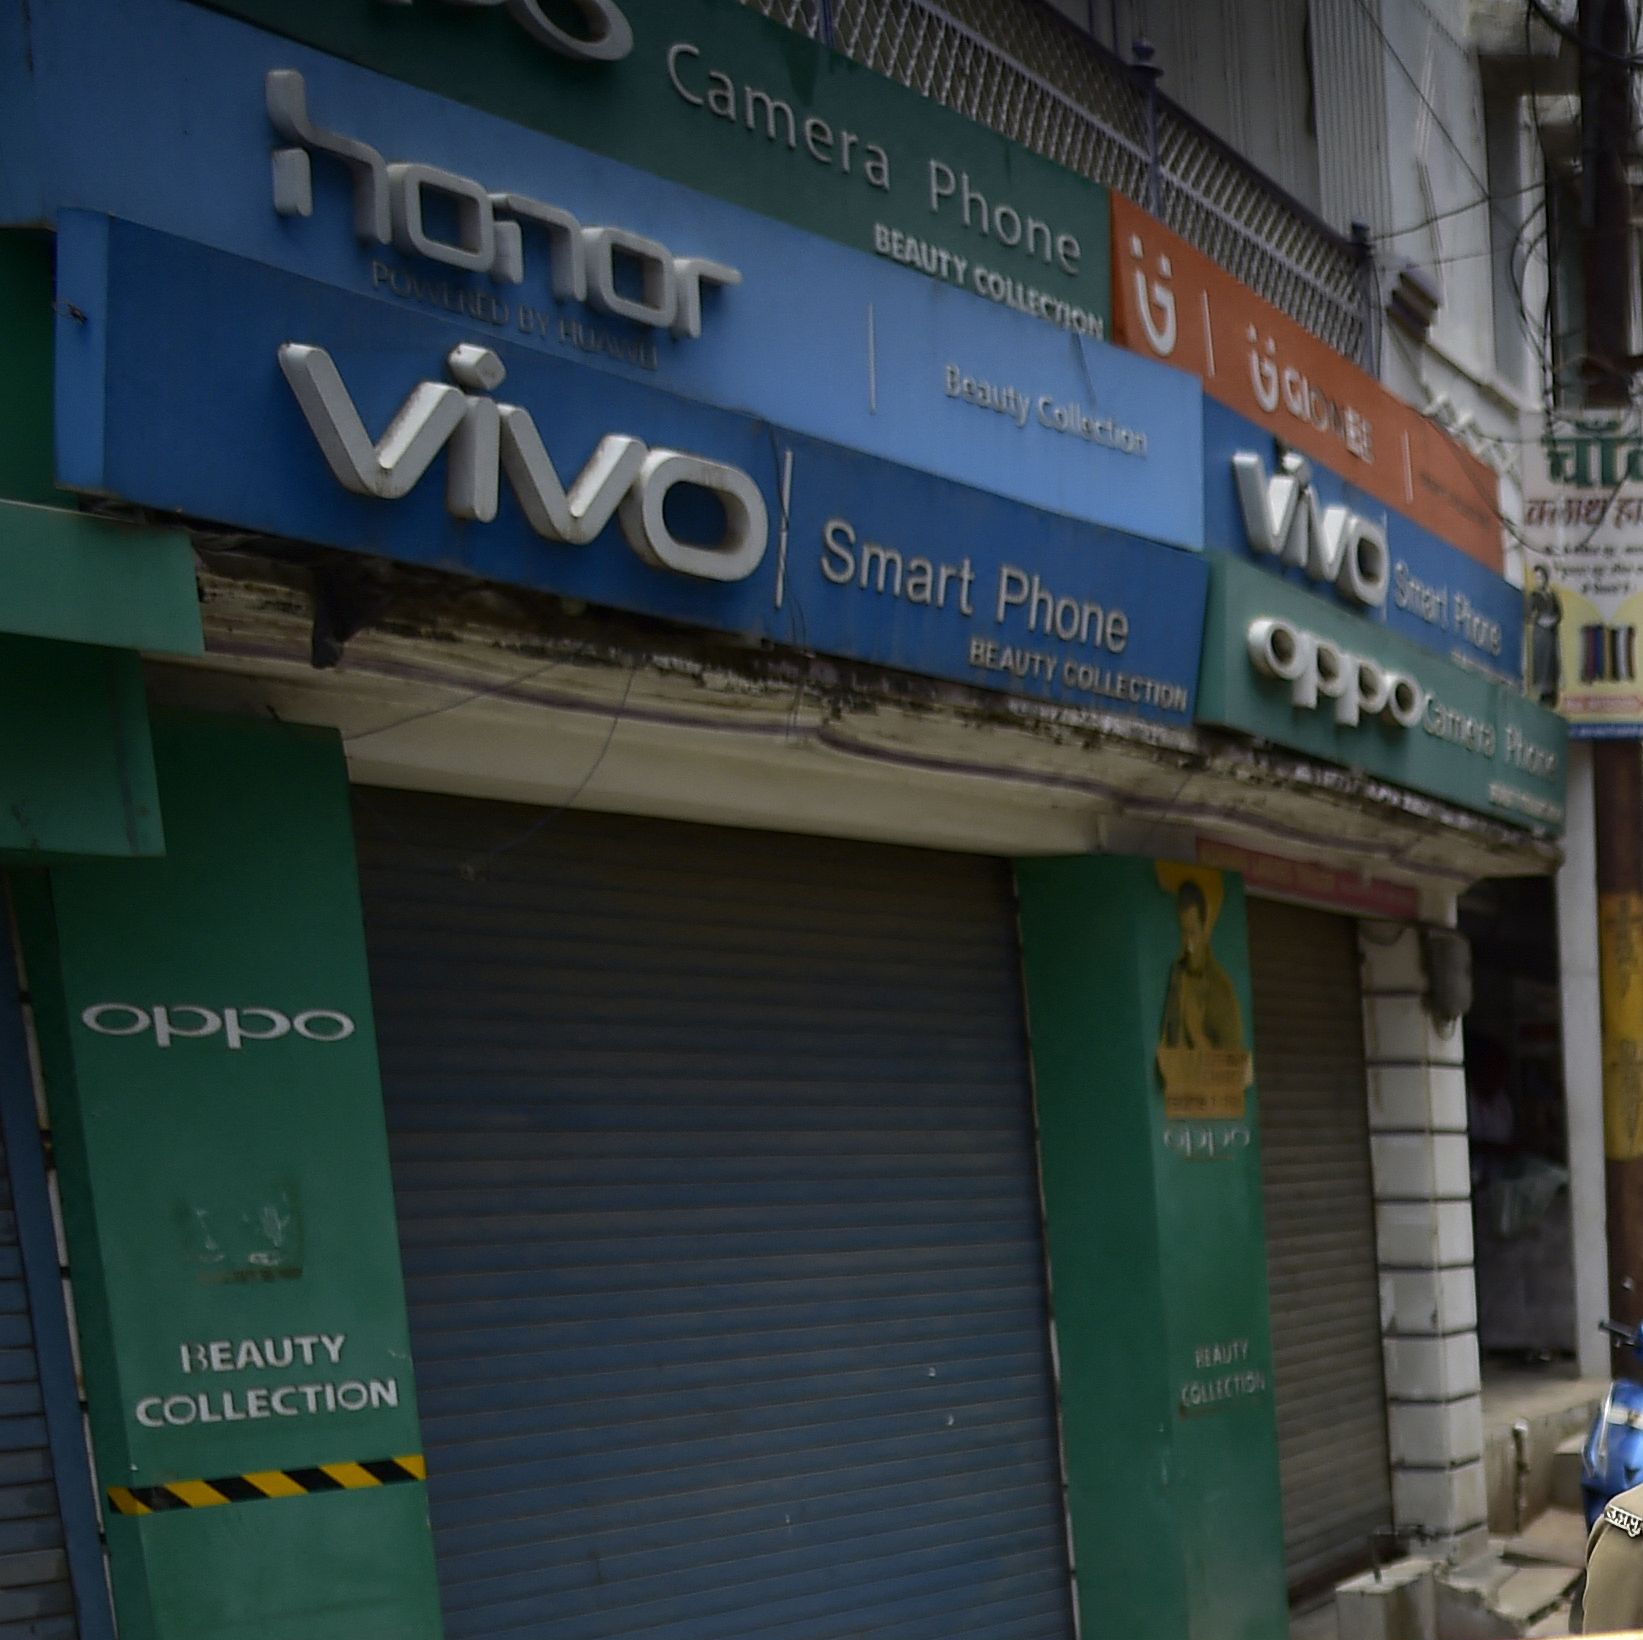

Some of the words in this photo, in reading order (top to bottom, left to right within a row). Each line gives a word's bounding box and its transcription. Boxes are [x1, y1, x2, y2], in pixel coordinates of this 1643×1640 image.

[666, 43, 890, 192] Camera
[928, 158, 1081, 277] Phone
[265, 68, 742, 338] honor
[517, 304, 550, 338] BY
[874, 222, 967, 284] BEAUTY
[974, 262, 1104, 341] COLLECTION
[944, 363, 1030, 428] Beauty
[1038, 397, 1148, 457] Collection
[278, 342, 768, 583] vivo
[820, 518, 975, 617] Smart
[995, 565, 1130, 654] Phone
[969, 637, 1058, 682] BEAUTY
[1063, 661, 1188, 714] COLLECTION
[1247, 617, 1426, 729] oppo
[82, 1003, 356, 1050] oppo
[180, 1334, 346, 1375] BEAUTY
[1181, 1371, 1265, 1407] COLLECTION
[1195, 1340, 1249, 1369] BEAUTY
[135, 1379, 398, 1430] COLLECTION
